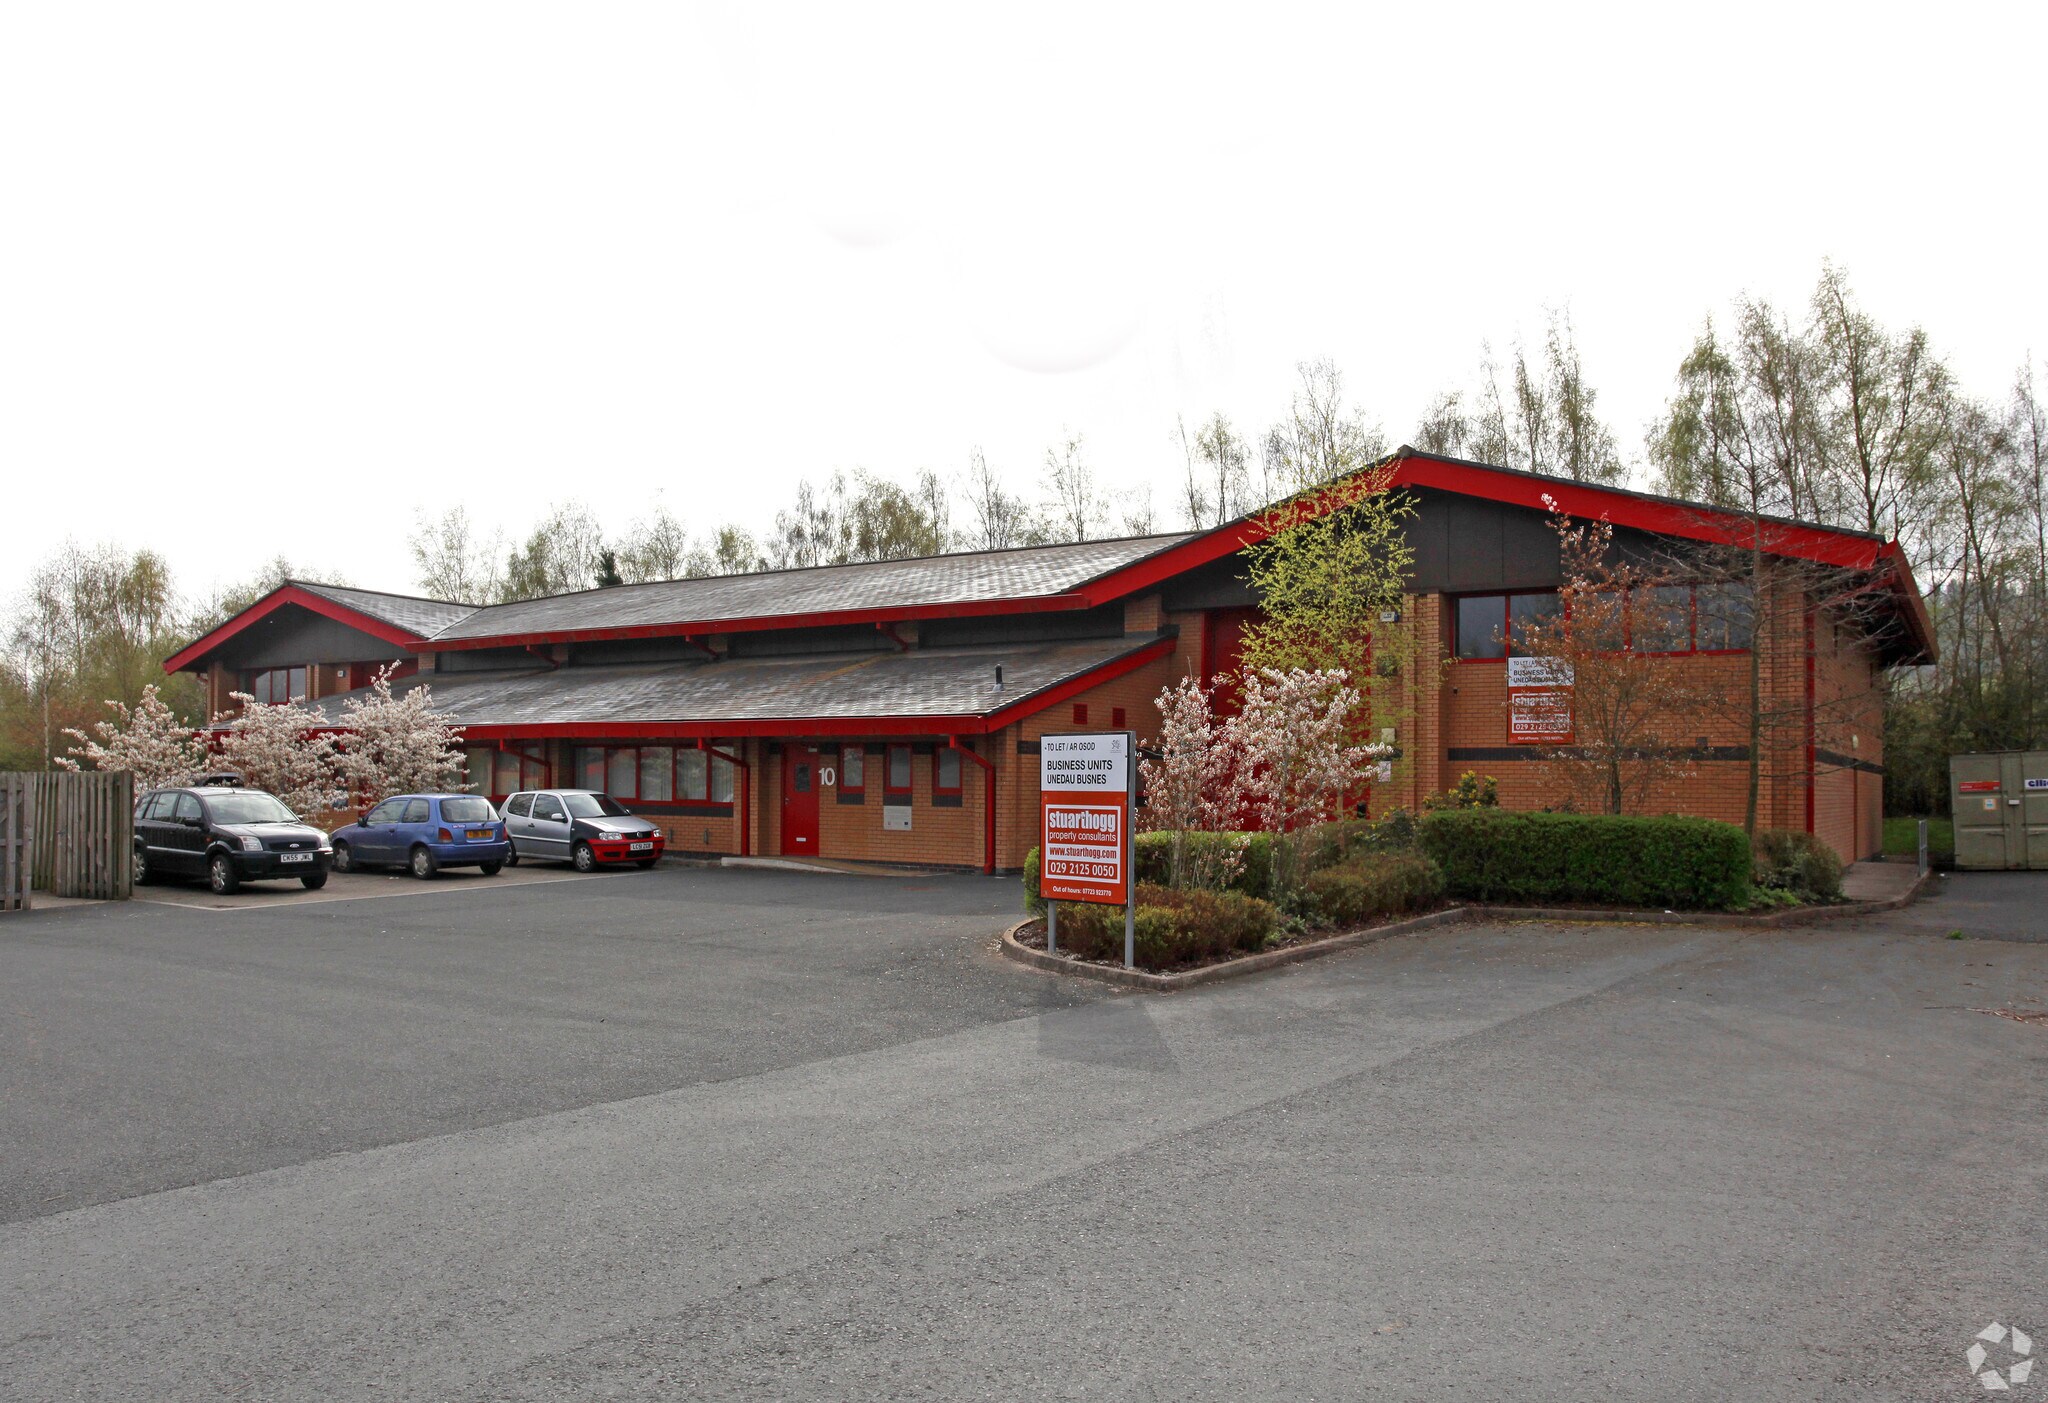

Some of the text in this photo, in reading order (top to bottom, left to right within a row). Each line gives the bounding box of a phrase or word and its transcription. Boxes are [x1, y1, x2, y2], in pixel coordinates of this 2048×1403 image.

[1047, 743, 1054, 751] TO
[1055, 743, 1065, 751] LET
[1069, 743, 1077, 751] AR
[1079, 742, 1095, 750] OSOD
[1047, 760, 1113, 770] BUSINESS UNITS
[818, 767, 836, 786] 10
[1047, 774, 1106, 784] UNEDAU BUSNES
[1049, 811, 1116, 832] stuarthogg
[1049, 831, 1117, 842] property consultants
[1049, 847, 1117, 859] www.stuarthogg.com
[1050, 862, 1115, 877] 029 2125 0050
